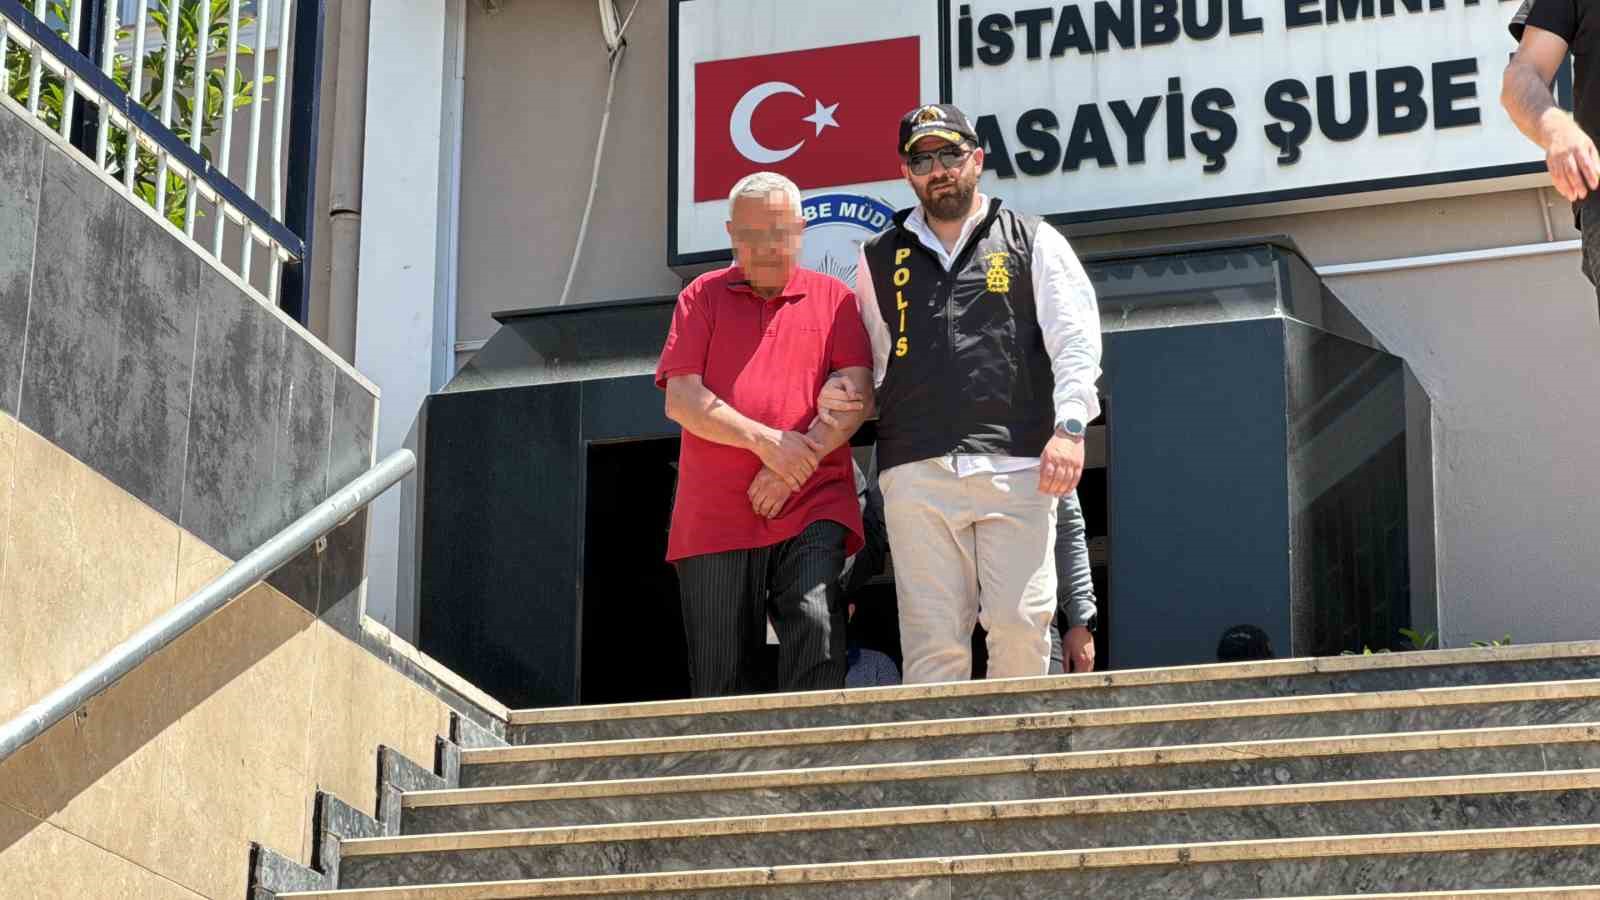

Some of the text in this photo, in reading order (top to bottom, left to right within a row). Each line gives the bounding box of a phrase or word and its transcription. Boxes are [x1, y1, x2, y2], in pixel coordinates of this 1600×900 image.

[958, 0, 1264, 69] İSTANBUL
[975, 76, 1238, 178] ASAYİŞ
[1264, 57, 1482, 166] ŞUBE
